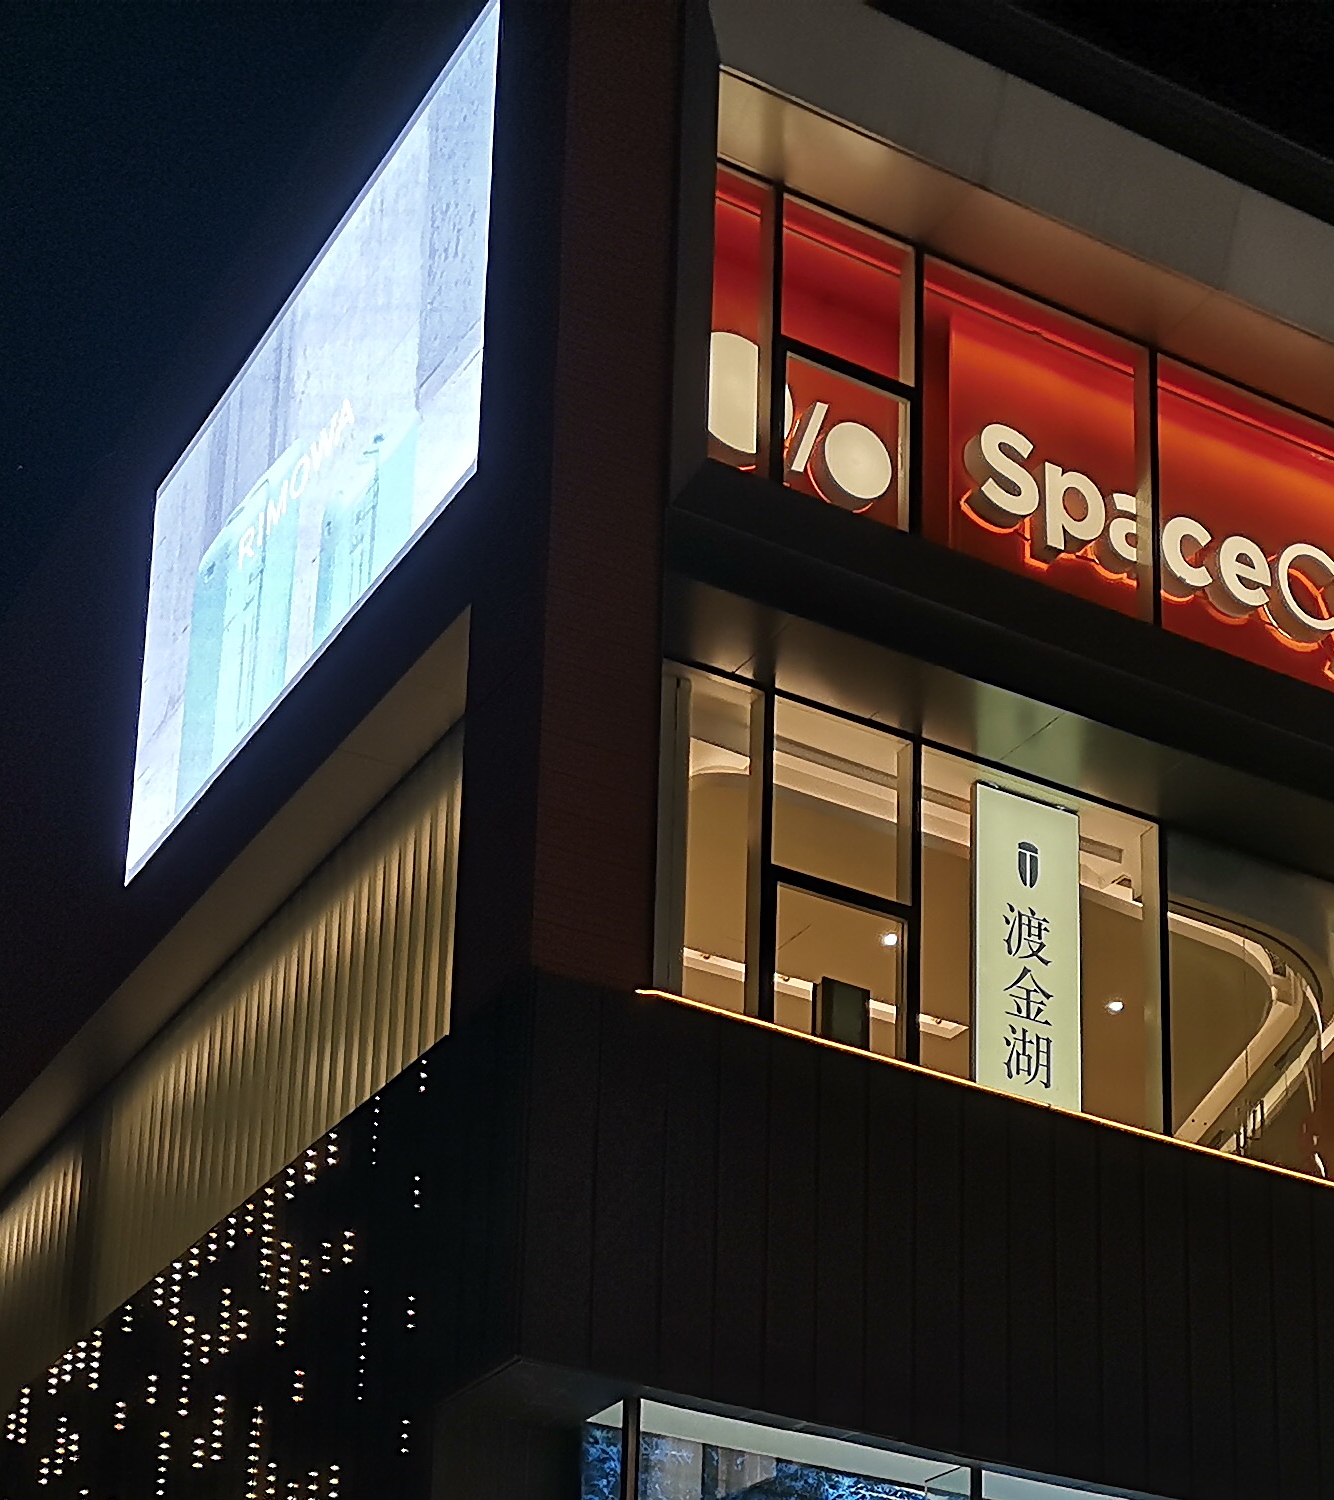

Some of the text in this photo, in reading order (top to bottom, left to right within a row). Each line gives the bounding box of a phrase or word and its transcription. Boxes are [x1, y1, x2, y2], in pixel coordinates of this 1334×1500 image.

[238, 397, 355, 571] RIMOWA
[1001, 901, 1055, 1091] 渡金湖
